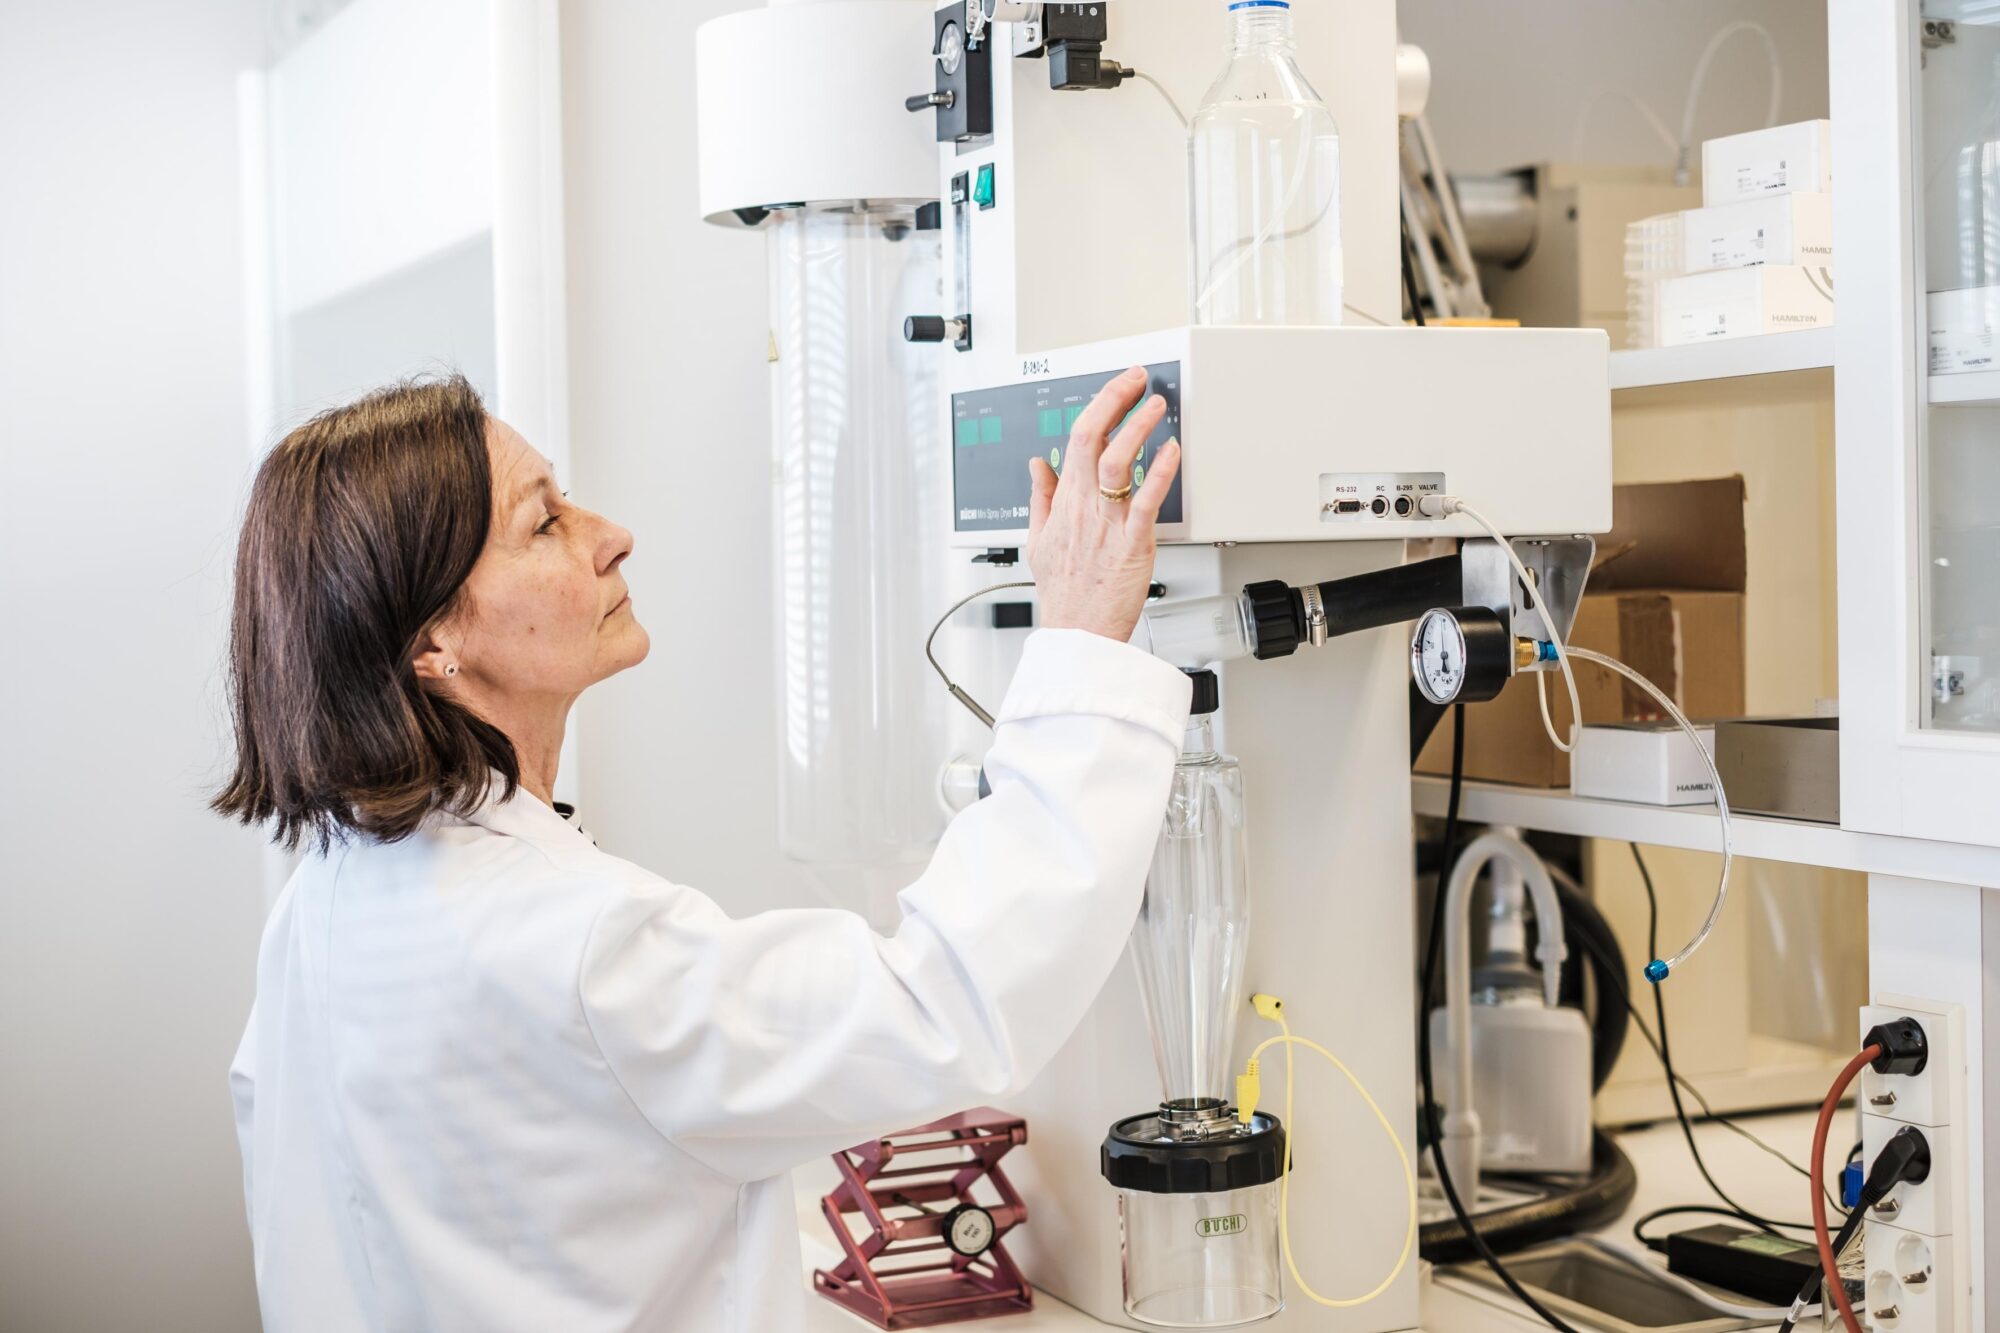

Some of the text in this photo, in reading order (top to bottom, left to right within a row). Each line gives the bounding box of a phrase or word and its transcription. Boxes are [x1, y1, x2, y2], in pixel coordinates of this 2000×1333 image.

[1801, 246, 1832, 254] HAMILT
[1772, 314, 1817, 323] HAMILTON
[1676, 783, 1713, 792] HAMILT
[1203, 1216, 1240, 1233] BÜCHI
